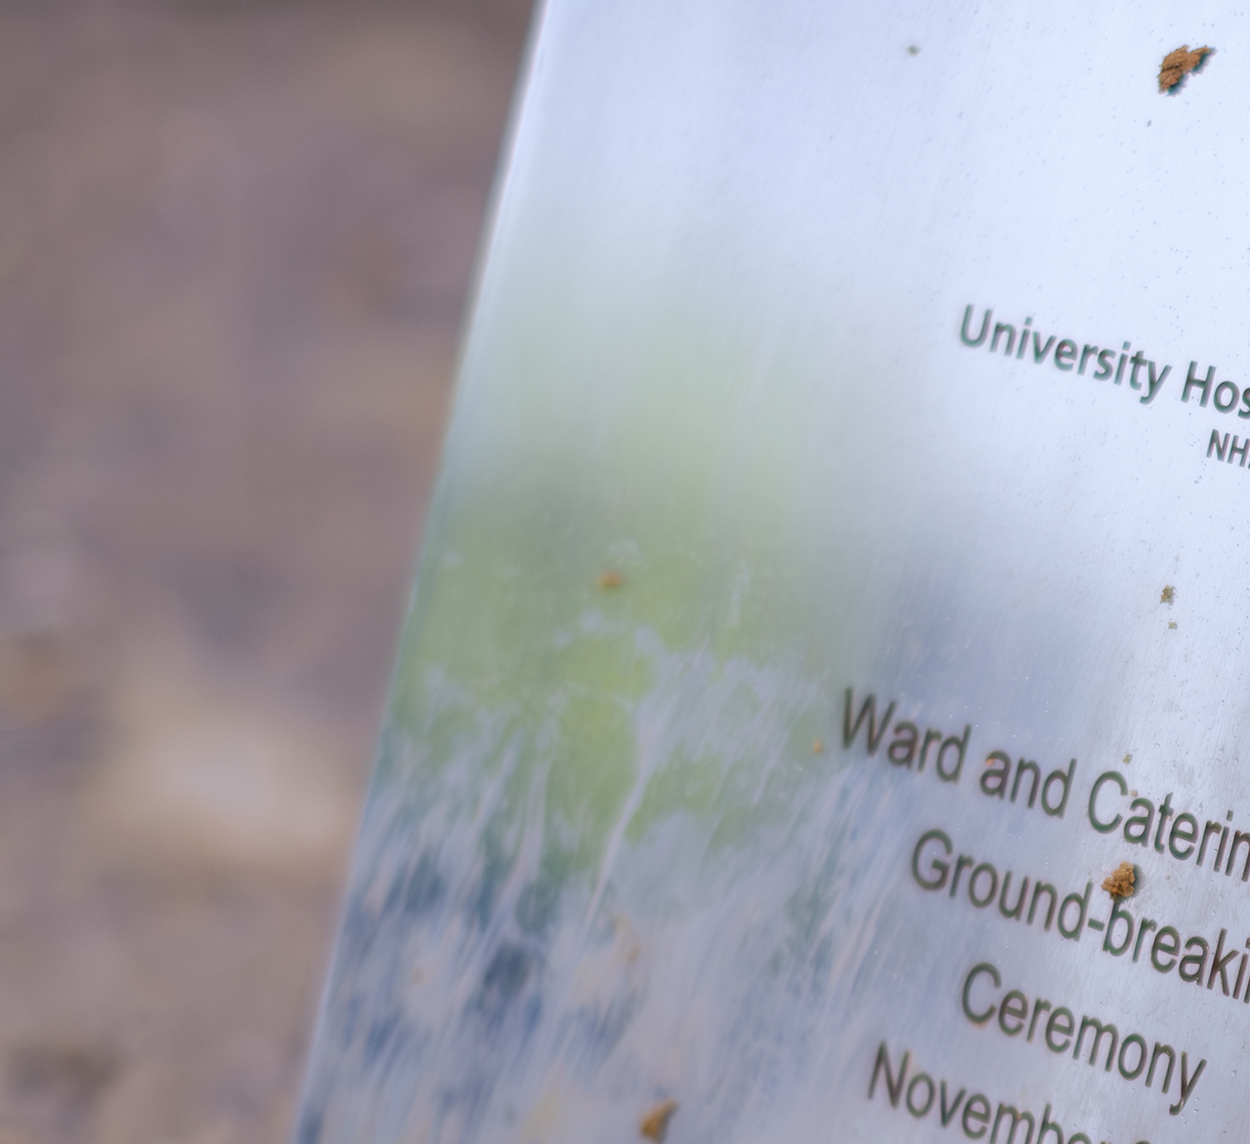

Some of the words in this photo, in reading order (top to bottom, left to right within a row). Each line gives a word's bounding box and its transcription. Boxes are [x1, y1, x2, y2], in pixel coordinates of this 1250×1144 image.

[958, 303, 1172, 405] University
[841, 688, 971, 784] Ward
[979, 751, 1077, 818] and
[962, 962, 1207, 1116] Ceremony
